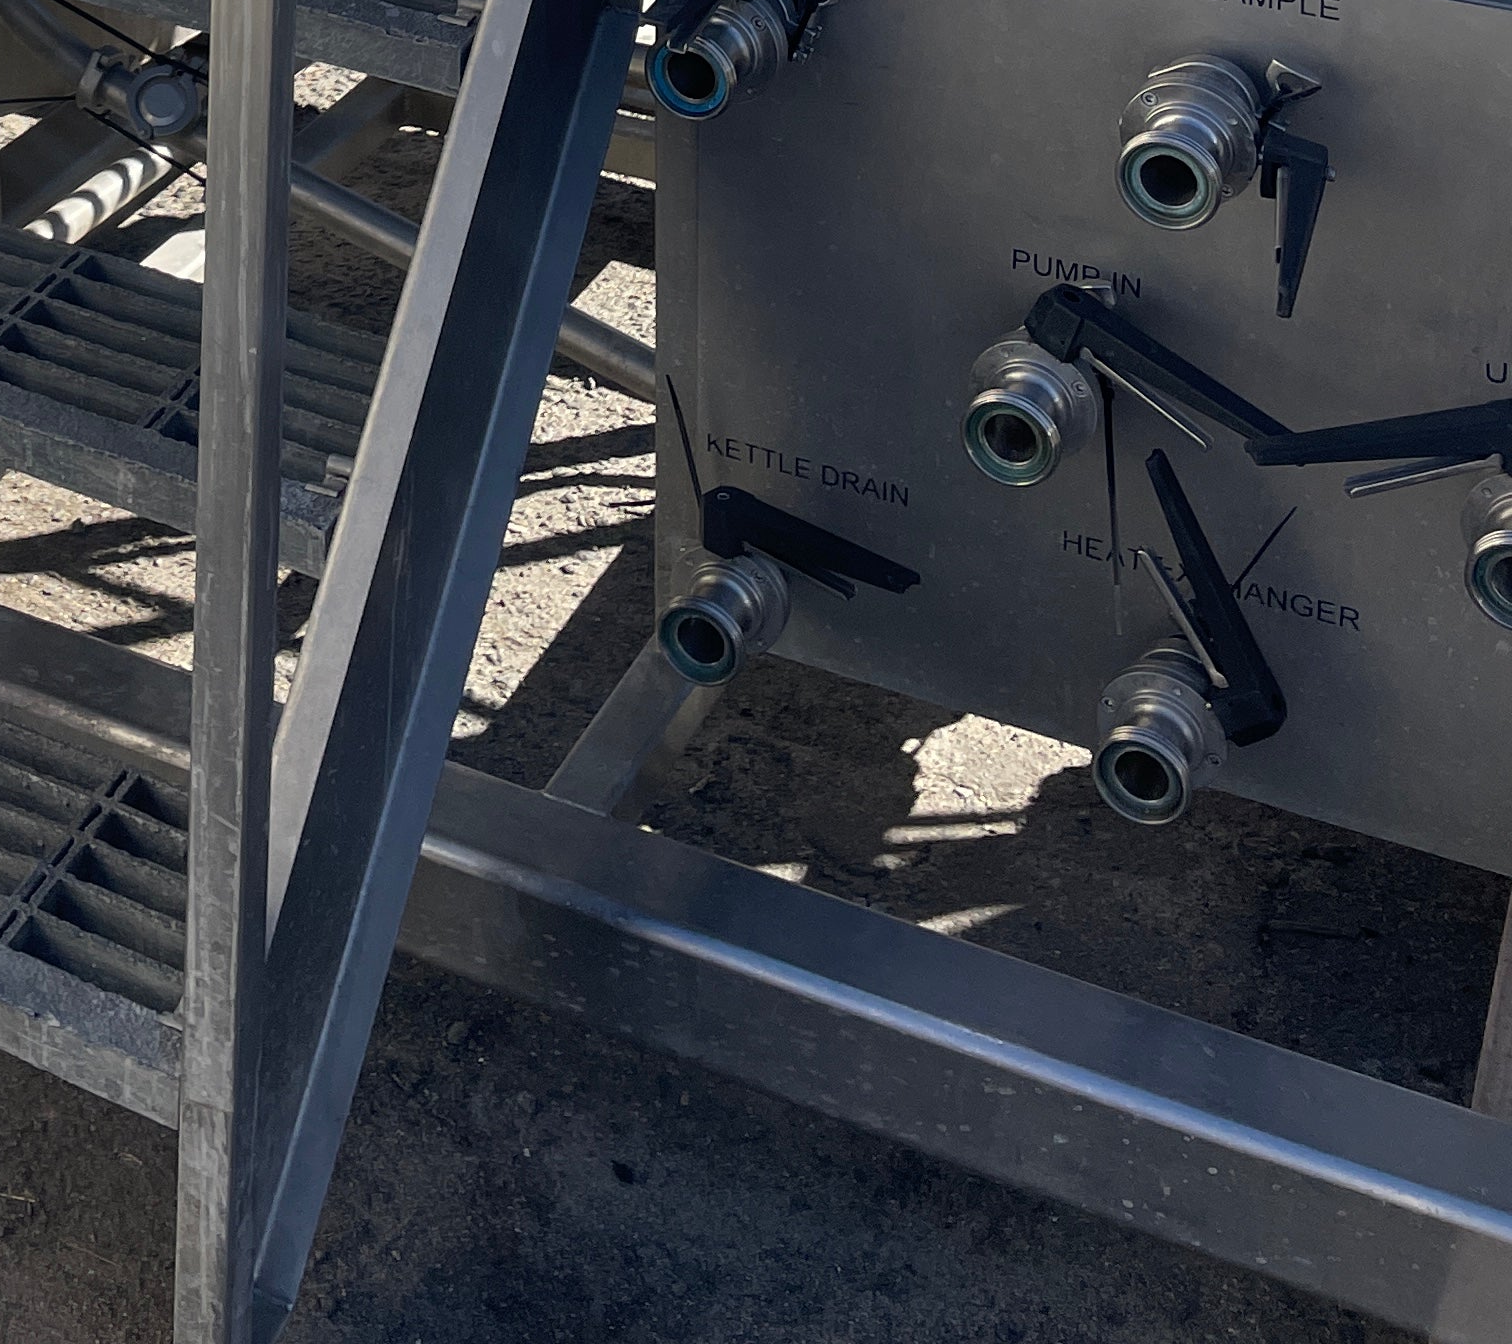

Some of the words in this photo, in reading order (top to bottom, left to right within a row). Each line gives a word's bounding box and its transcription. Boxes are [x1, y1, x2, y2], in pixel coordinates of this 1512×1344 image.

[1012, 248, 1101, 282] PUMP
[1112, 272, 1141, 298] IN
[707, 433, 812, 480] KETTLE
[822, 465, 910, 507] DRAIN
